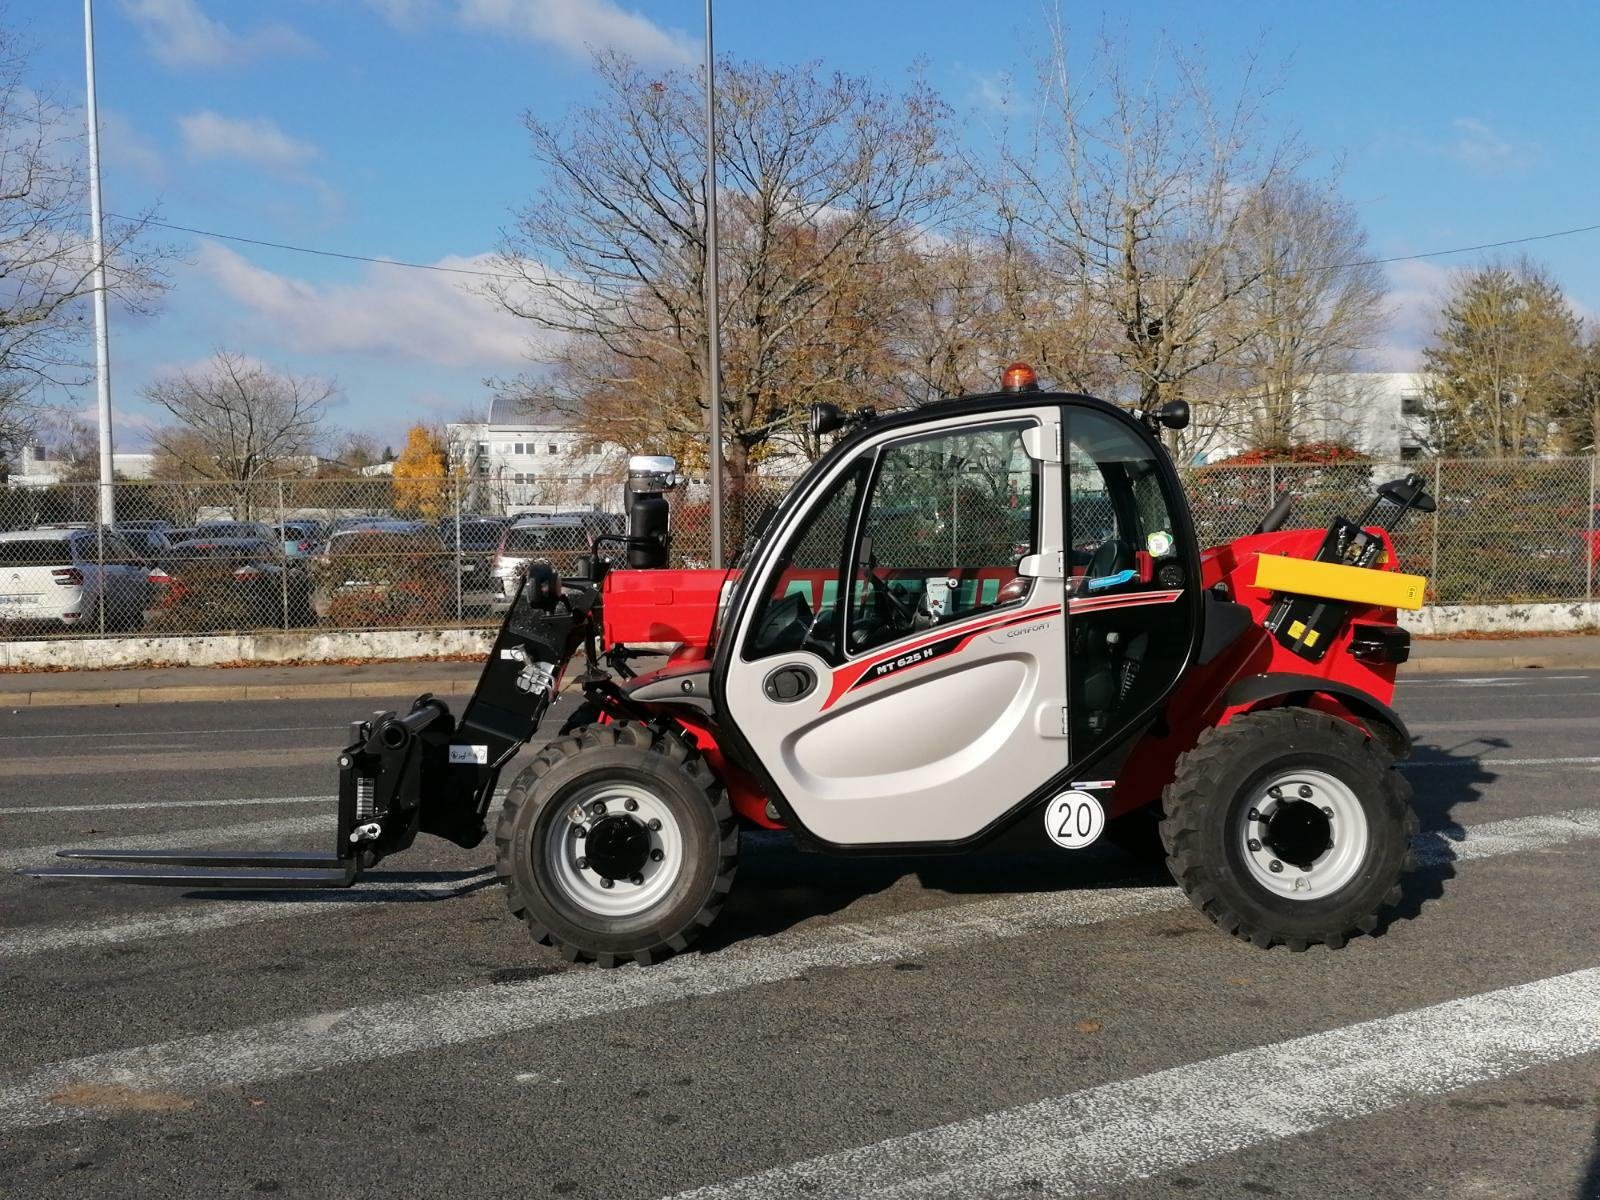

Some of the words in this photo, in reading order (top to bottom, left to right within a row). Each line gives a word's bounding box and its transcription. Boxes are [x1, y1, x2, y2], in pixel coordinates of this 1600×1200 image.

[876, 661, 896, 675] MT
[897, 652, 922, 668] 625
[923, 648, 933, 658] H
[1057, 802, 1092, 838] 20
